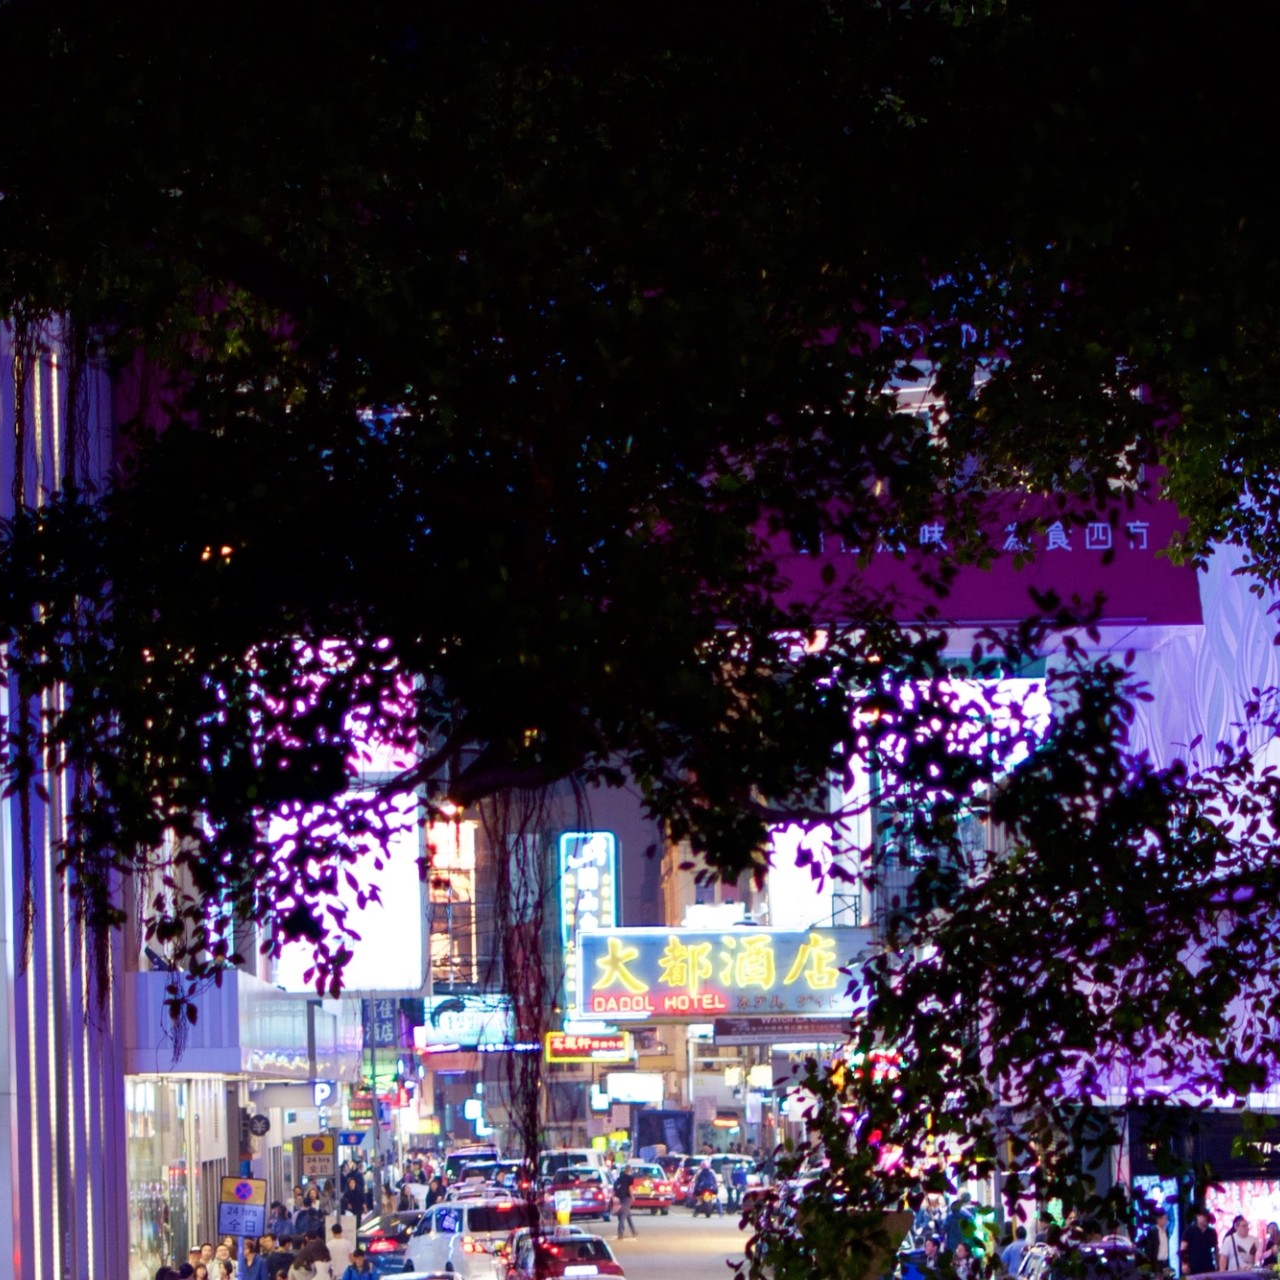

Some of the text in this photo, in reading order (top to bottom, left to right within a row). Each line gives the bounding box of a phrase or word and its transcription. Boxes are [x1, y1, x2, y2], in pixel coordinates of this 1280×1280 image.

[593, 933, 839, 998] 大都酒店
[664, 993, 726, 1010] HOTEL
[738, 994, 783, 1010] ホテル
[314, 1083, 331, 1106] P
[306, 1156, 330, 1164] 24 hrs
[227, 1206, 257, 1217] 24 hrs
[228, 1219, 256, 1233] 全日
